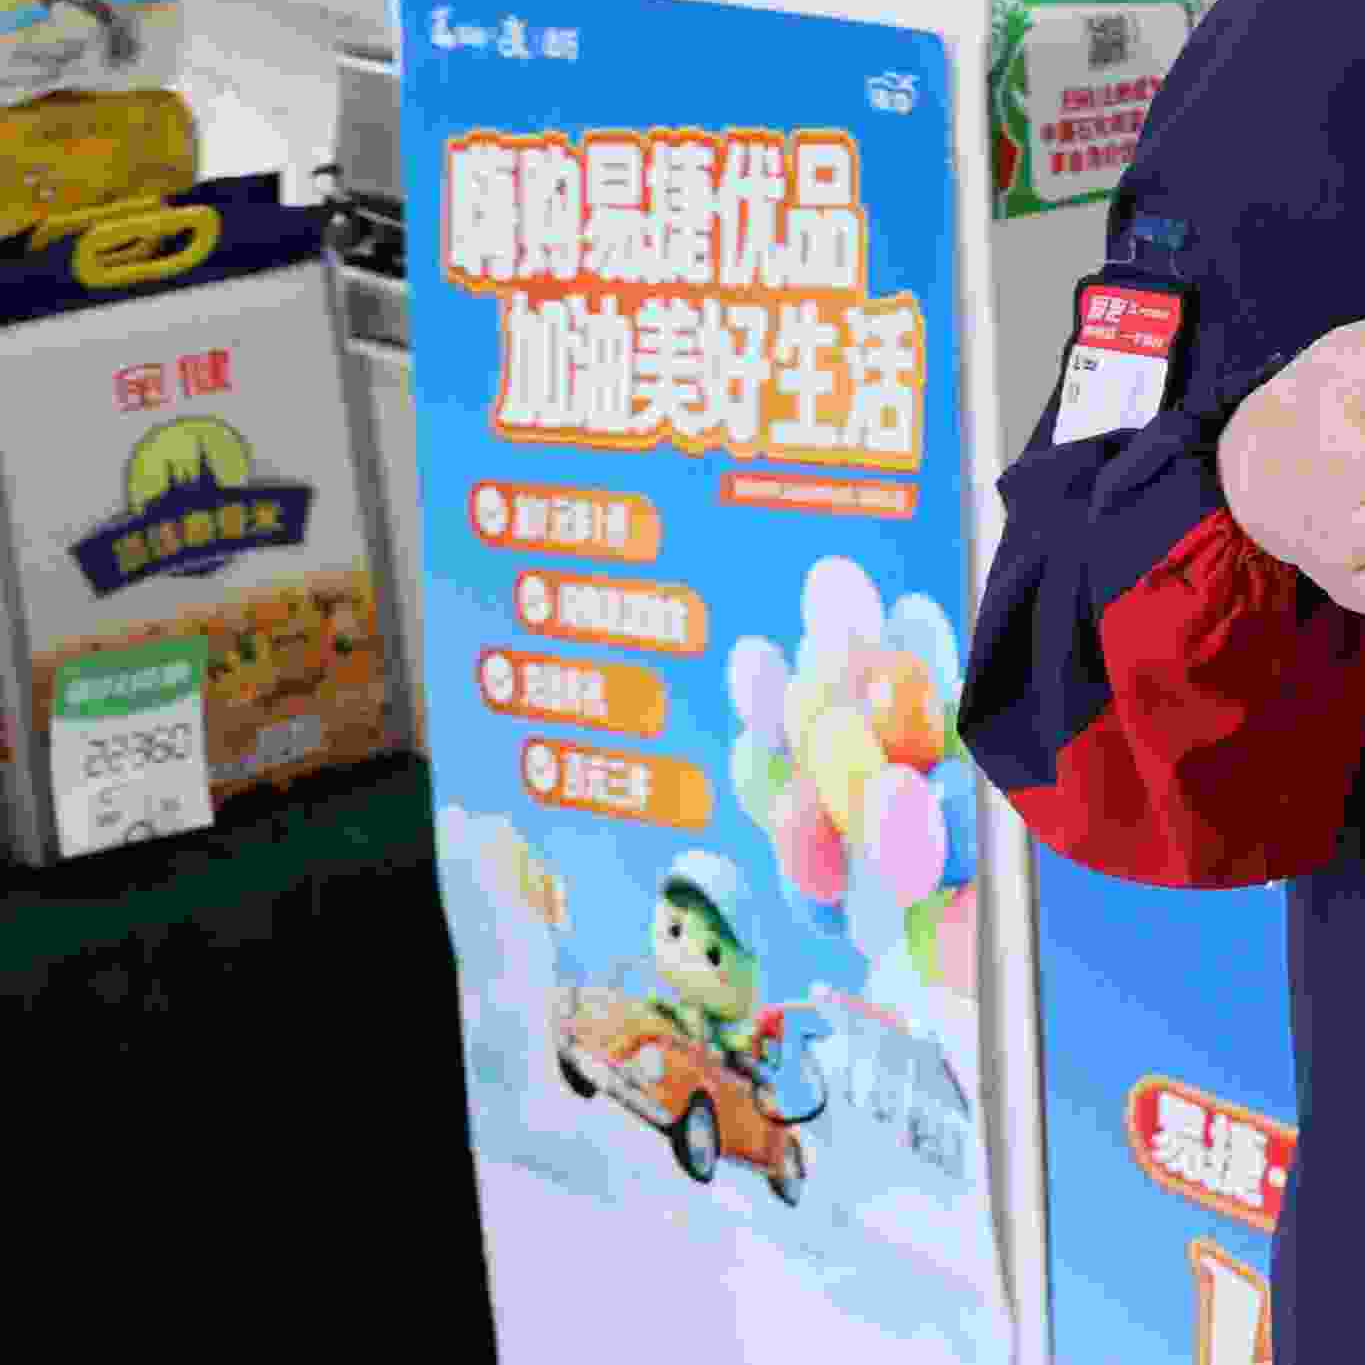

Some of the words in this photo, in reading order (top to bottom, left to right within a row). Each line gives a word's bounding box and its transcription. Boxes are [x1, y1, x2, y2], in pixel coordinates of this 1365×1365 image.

[498, 292, 914, 453] 加油美好生活
